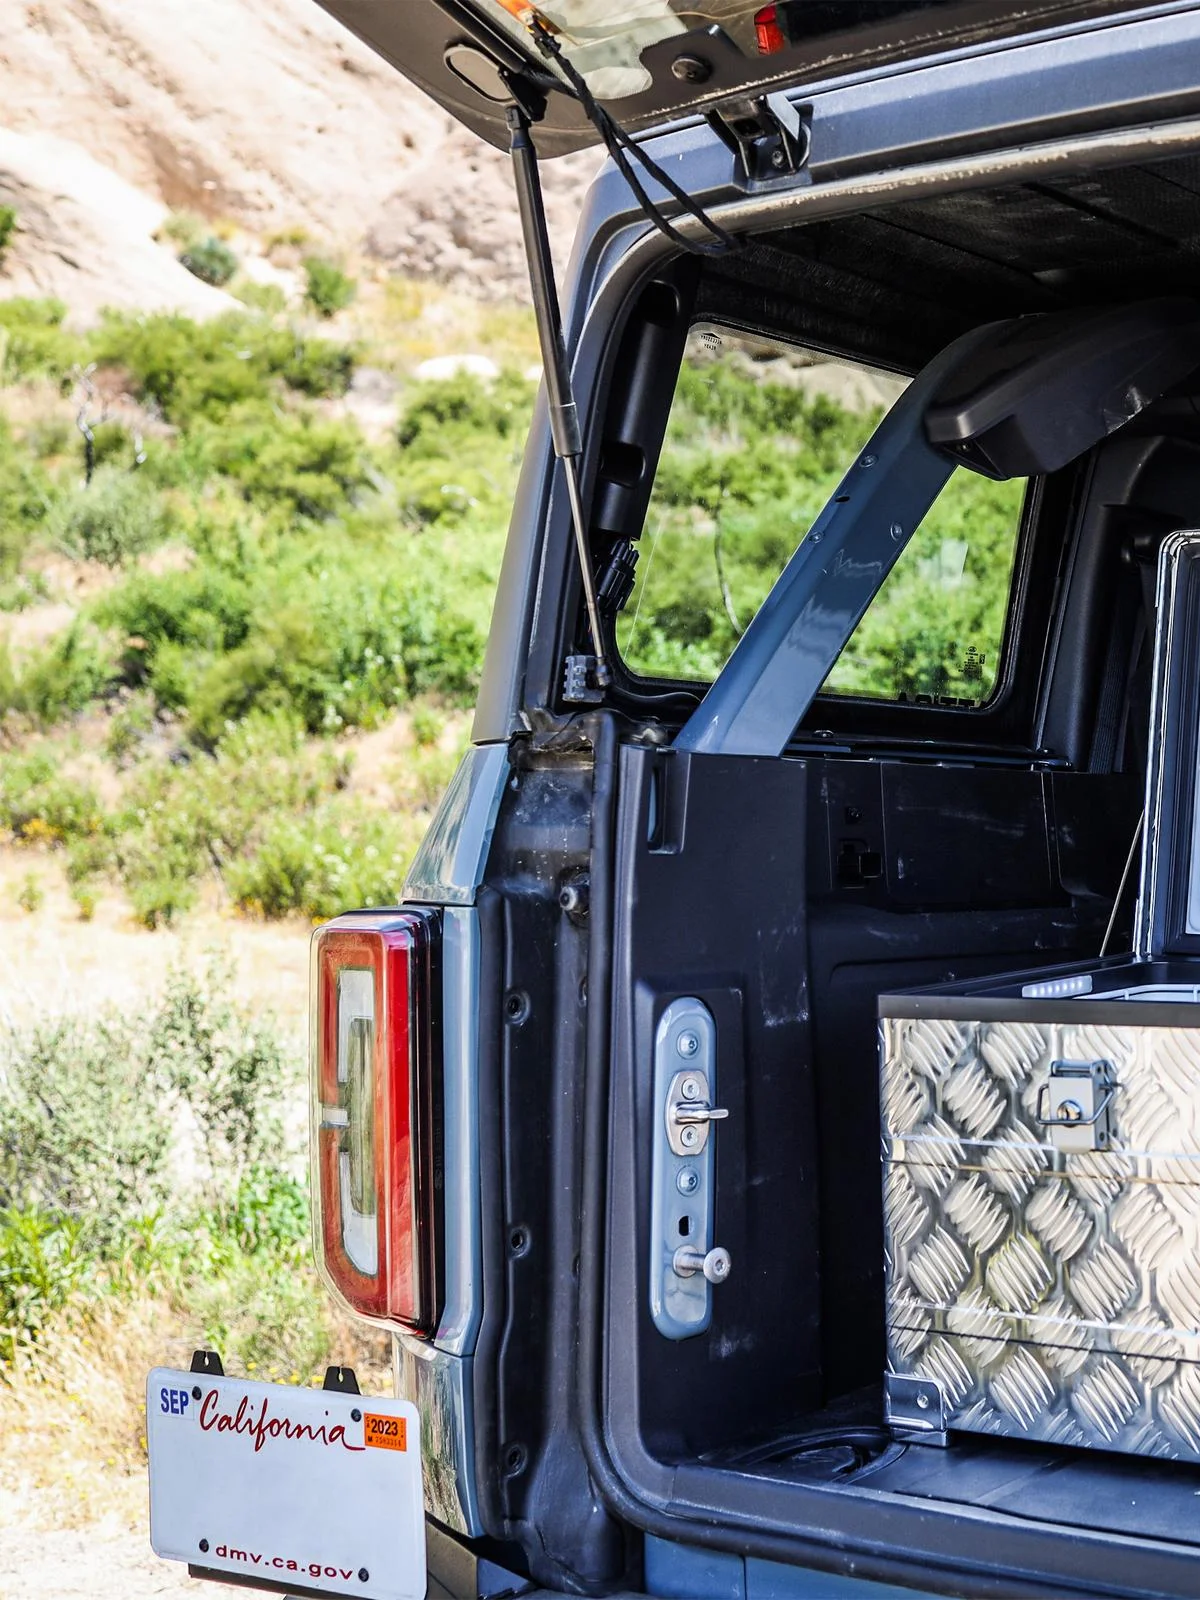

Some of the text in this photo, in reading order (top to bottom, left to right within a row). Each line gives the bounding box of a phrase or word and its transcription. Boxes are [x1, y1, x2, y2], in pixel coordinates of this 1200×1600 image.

[160, 1388, 189, 1415] SEP
[200, 1389, 366, 1452] California
[371, 1418, 398, 1436] 2023
[216, 1545, 353, 1580] dmv.ca.gov
